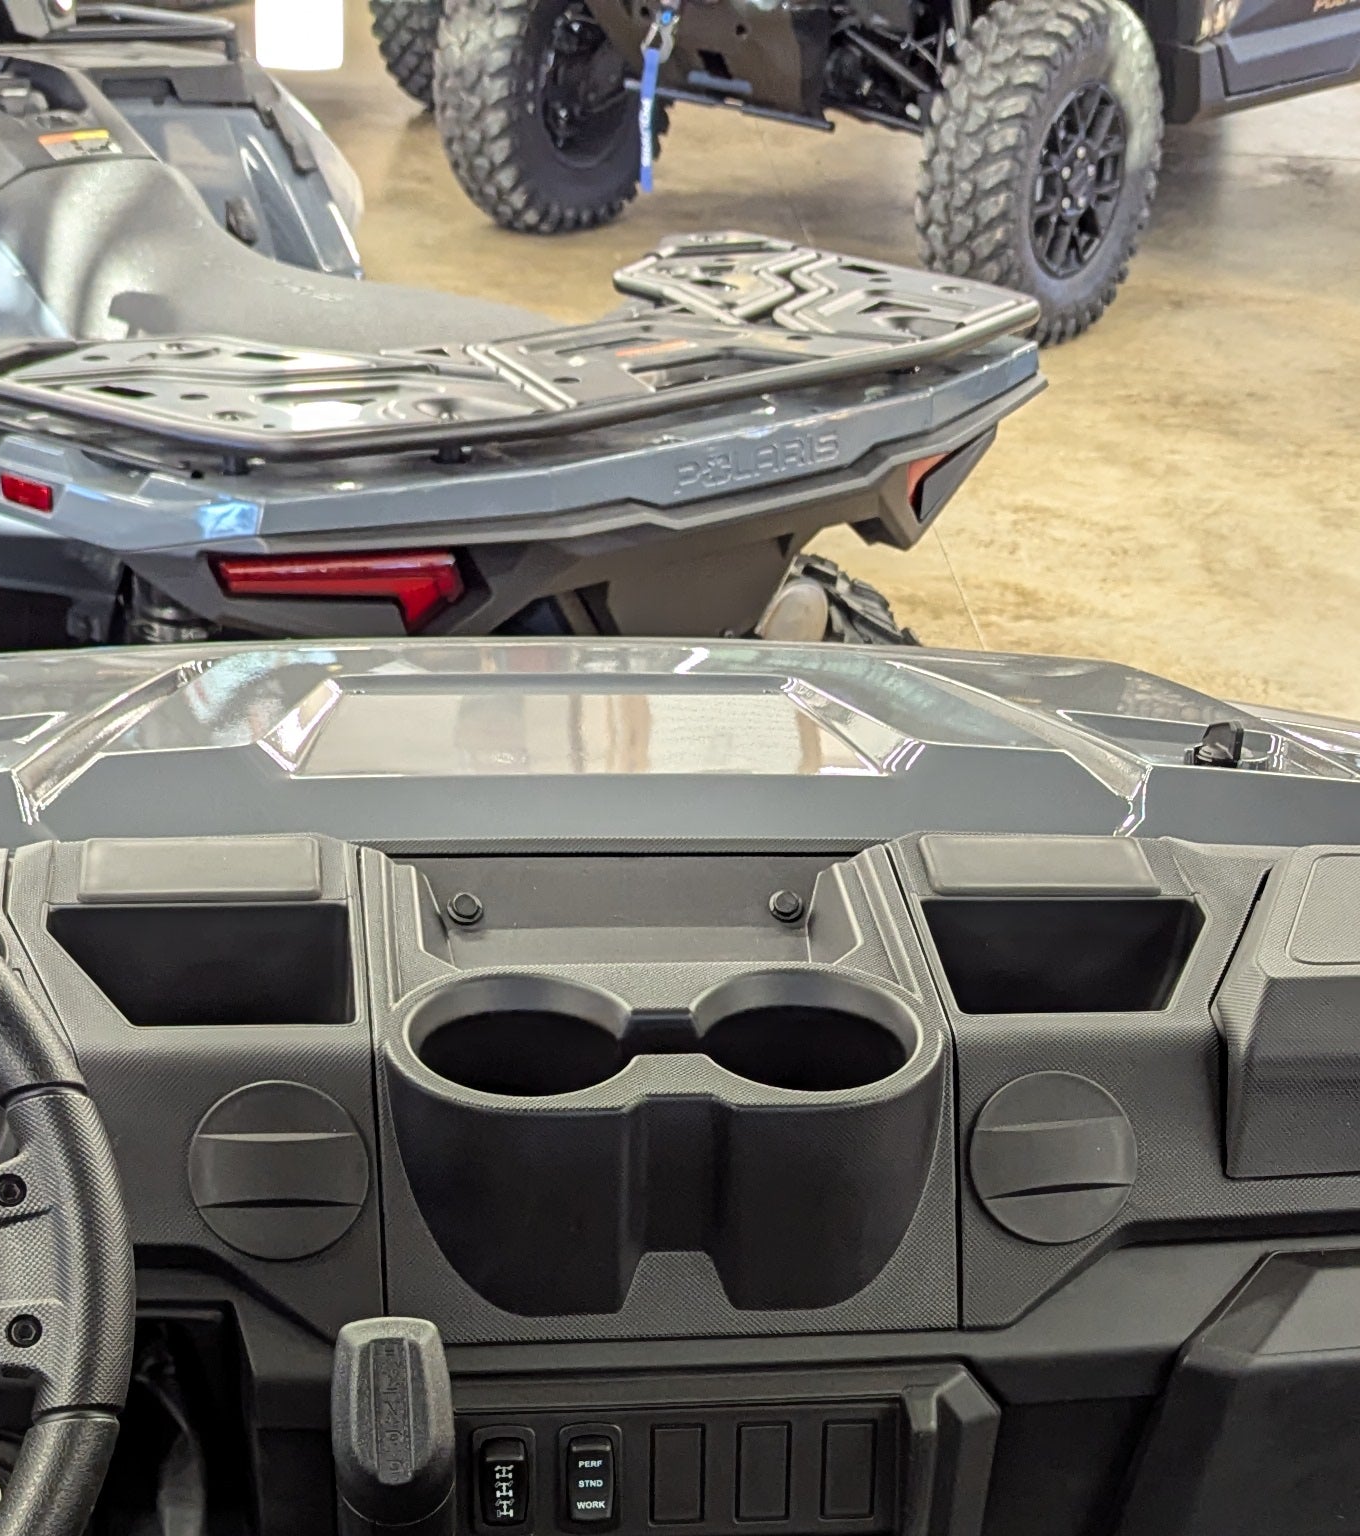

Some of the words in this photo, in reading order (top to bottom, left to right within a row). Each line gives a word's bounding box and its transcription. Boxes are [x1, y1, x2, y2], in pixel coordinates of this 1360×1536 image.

[672, 430, 840, 495] POLARIS
[578, 1460, 603, 1468] PERF
[578, 1479, 604, 1488] STND
[576, 1500, 606, 1510] WORK
